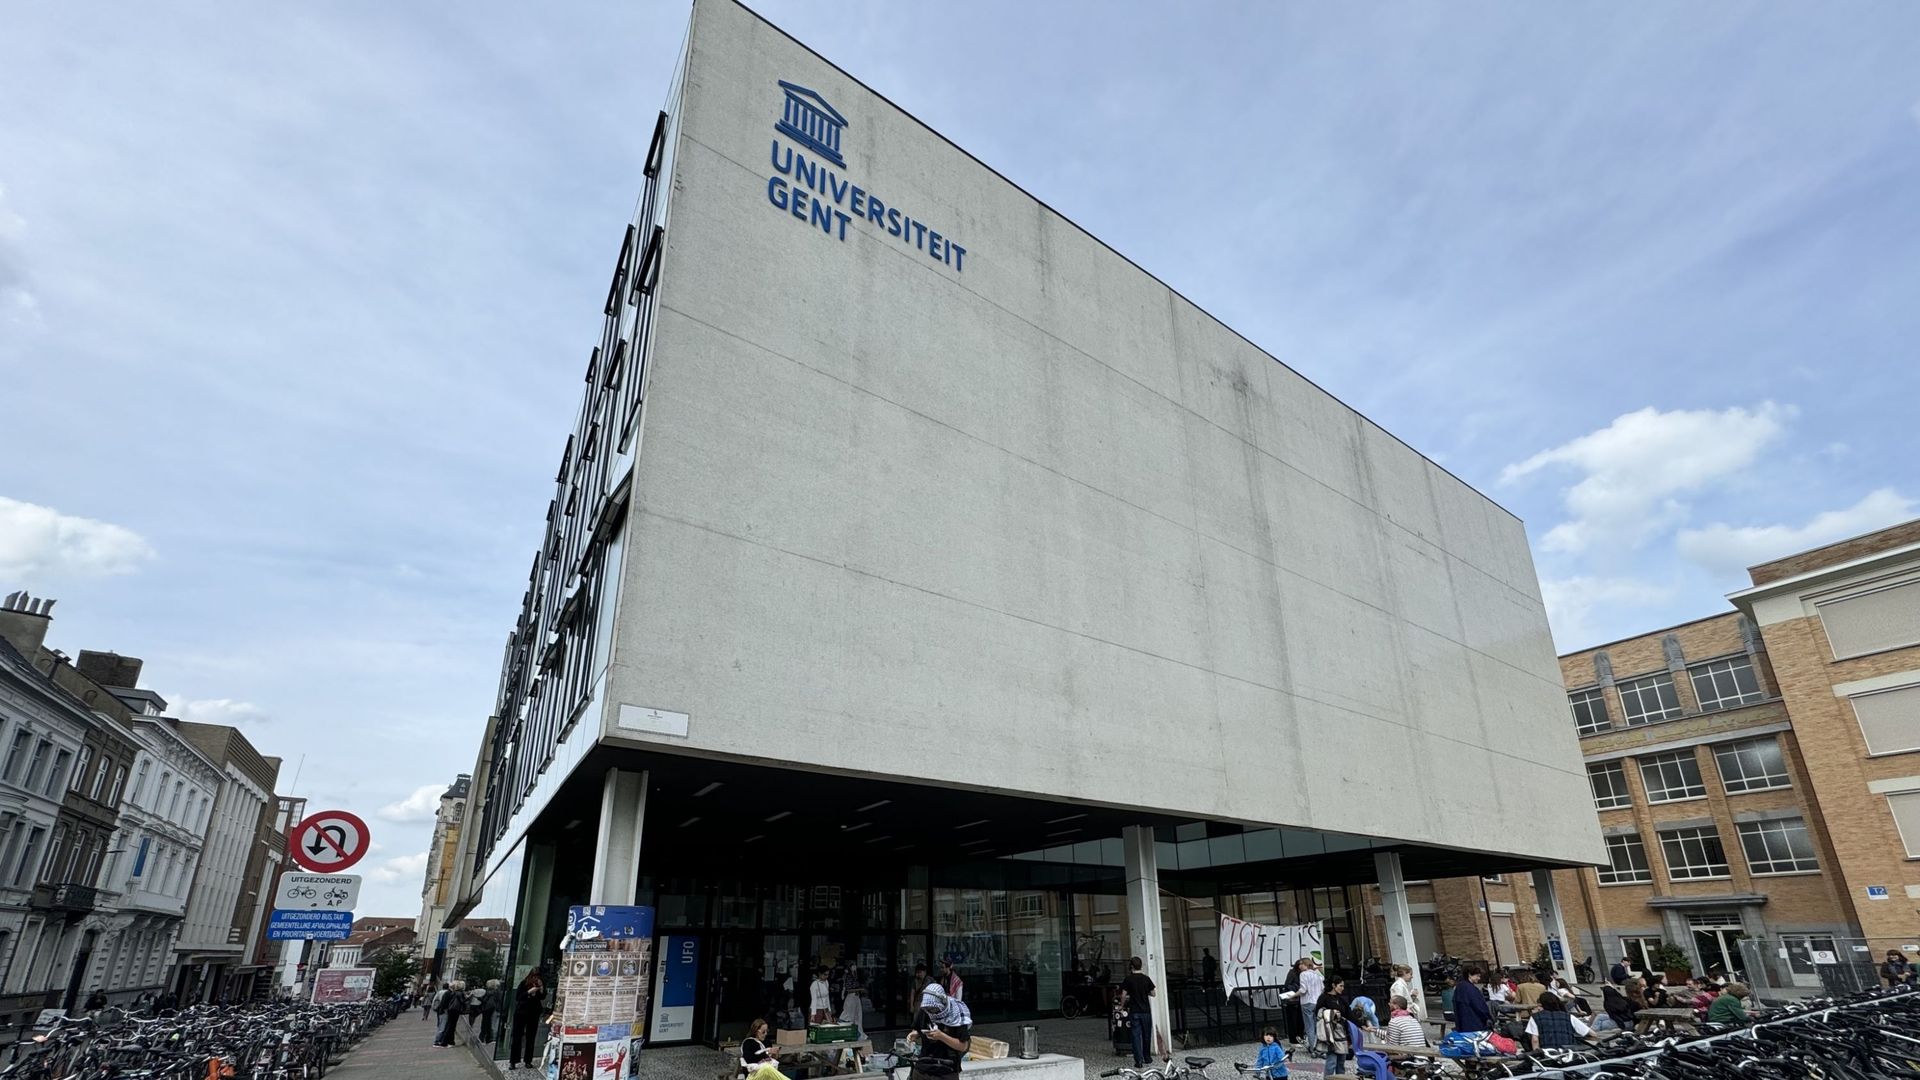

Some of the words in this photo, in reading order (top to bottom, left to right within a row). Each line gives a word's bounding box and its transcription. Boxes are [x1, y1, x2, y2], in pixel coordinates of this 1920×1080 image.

[768, 176, 852, 242] GENT
[771, 139, 967, 272] UNIVERSITEIT
[292, 876, 352, 884] UITGEZONDERD
[681, 941, 694, 963] UFO
